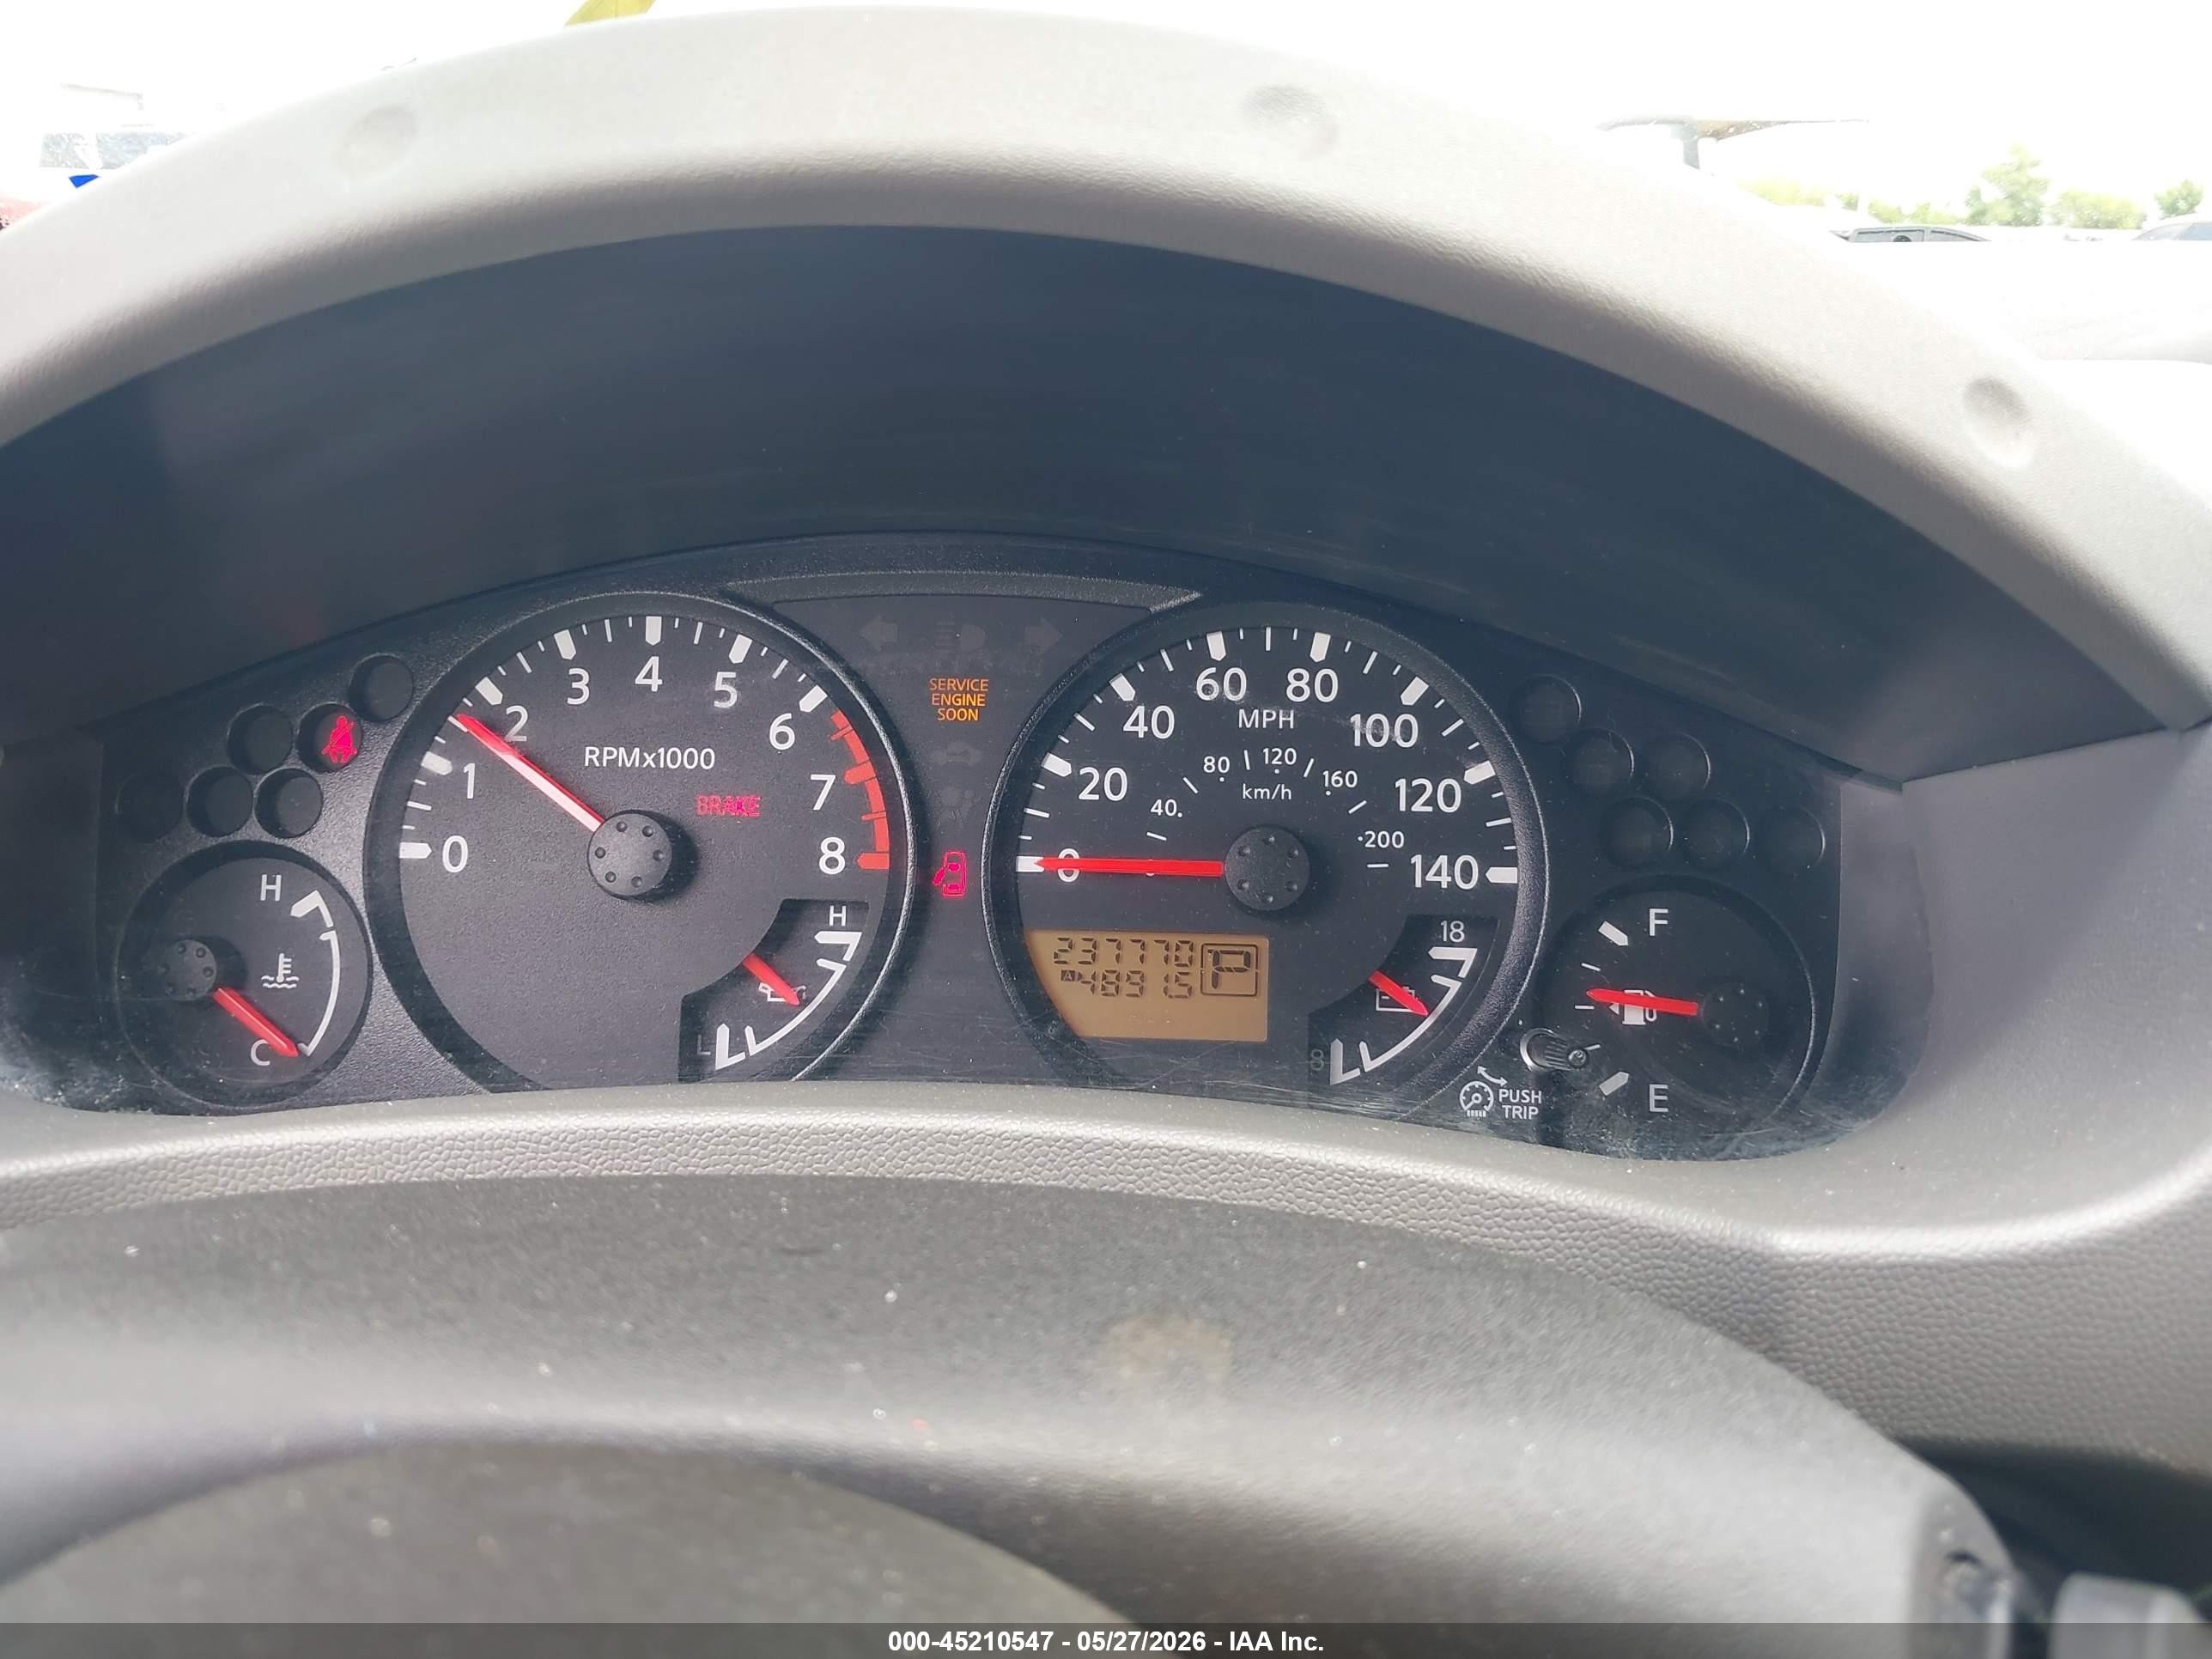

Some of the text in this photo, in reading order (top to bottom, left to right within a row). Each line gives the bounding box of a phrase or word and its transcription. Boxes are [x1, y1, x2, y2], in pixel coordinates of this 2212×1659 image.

[567, 668, 591, 705] 3
[635, 655, 663, 692] 4
[929, 678, 989, 692] SERVICE
[1196, 666, 1248, 701] 60
[1286, 668, 1339, 702] 80
[714, 672, 738, 708] 5
[931, 693, 986, 707] ENGINE
[506, 706, 527, 742] 2
[937, 708, 979, 722] SOON
[1122, 705, 1175, 739] 40
[1238, 709, 1295, 729] MPH
[769, 713, 795, 750] 6
[1350, 713, 1419, 748] 100
[584, 746, 715, 769] RPMx1000
[1203, 757, 1231, 773] 80
[1263, 748, 1297, 764] 120
[464, 763, 476, 799] 1
[810, 775, 836, 811] 7
[1078, 767, 1127, 801] 20
[1242, 783, 1292, 800] km/h
[1322, 771, 1358, 787] 160
[696, 796, 762, 816] BRAKE
[1151, 799, 1176, 816] 40
[1395, 779, 1461, 812] 120
[1364, 831, 1405, 848] 200
[442, 836, 469, 873] 0
[819, 837, 846, 874] 8
[1411, 854, 1479, 890] 140
[260, 874, 282, 901] H
[829, 905, 847, 927] H
[1649, 908, 1668, 936] F
[1441, 920, 1466, 944] 18
[1053, 937, 1194, 968] 237770
[1211, 950, 1251, 990] P
[250, 1040, 270, 1066] C
[1498, 1089, 1542, 1103] PUSH
[1649, 1084, 1668, 1112] E
[1502, 1104, 1539, 1120] TRIP
